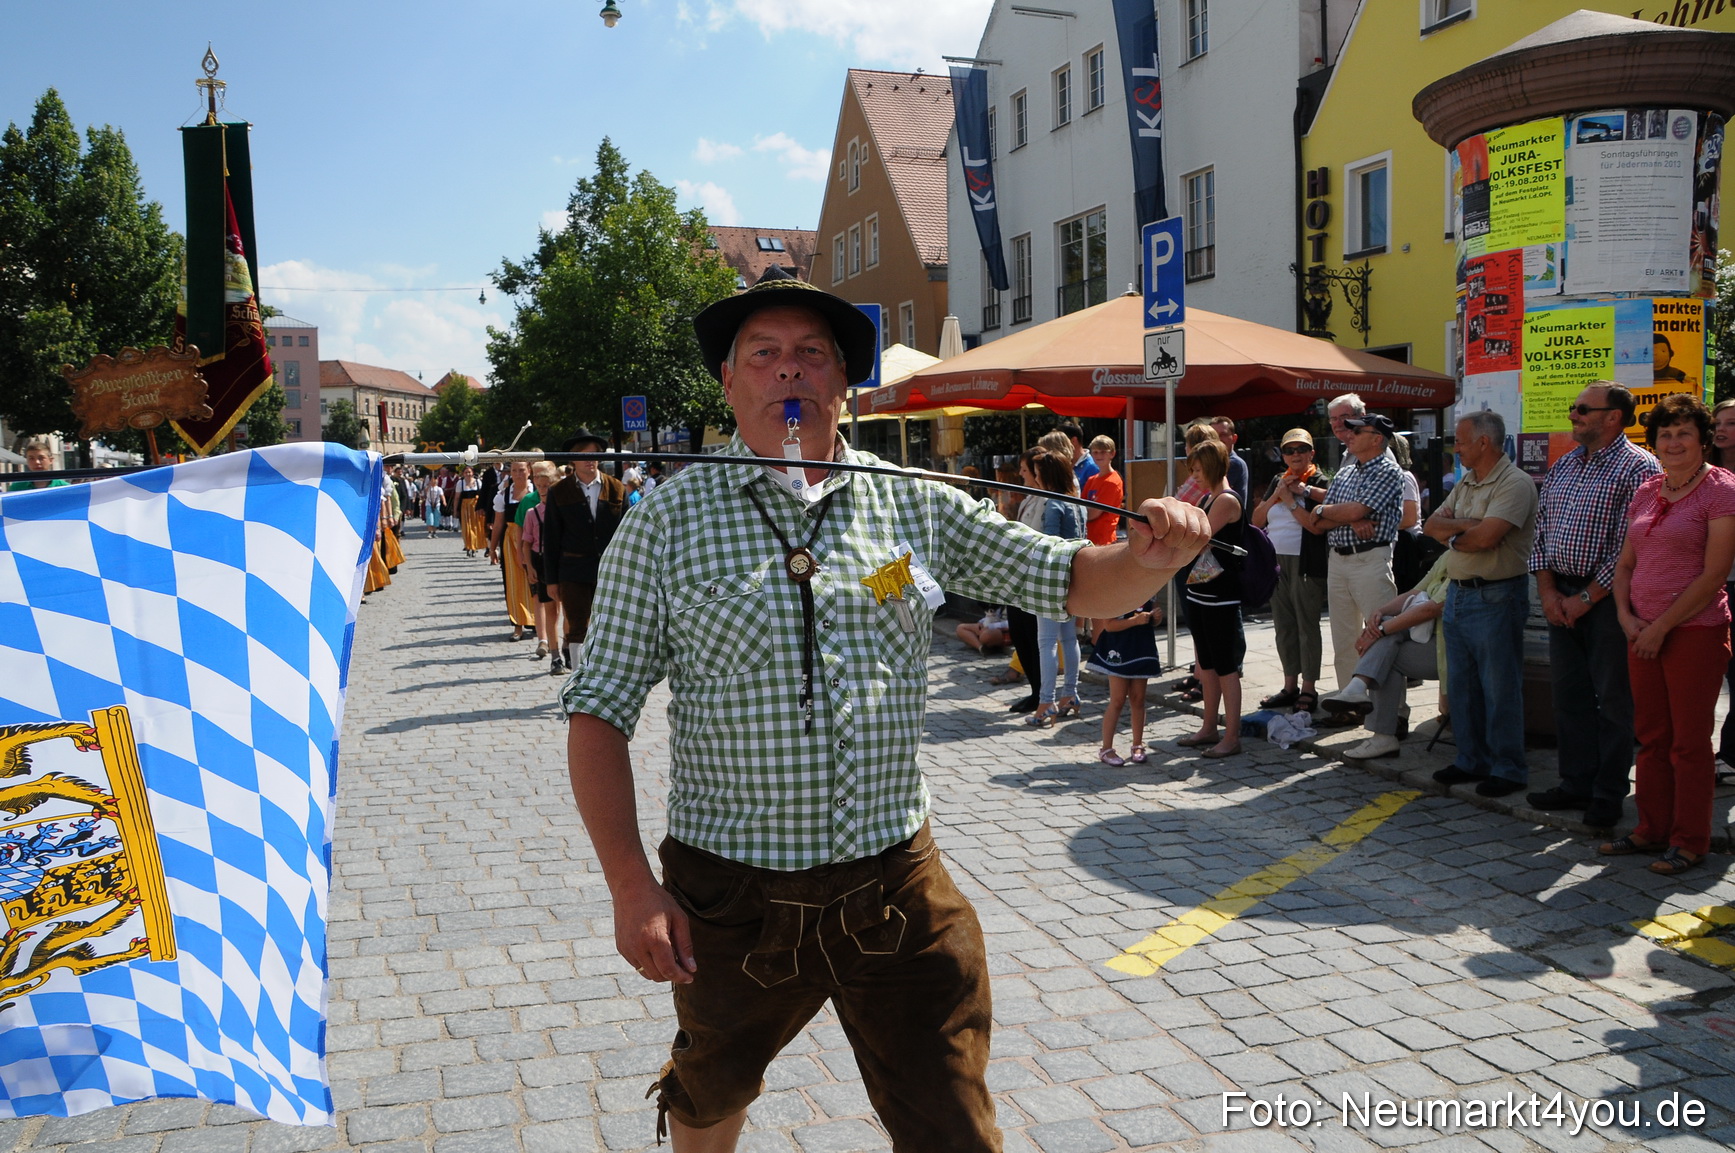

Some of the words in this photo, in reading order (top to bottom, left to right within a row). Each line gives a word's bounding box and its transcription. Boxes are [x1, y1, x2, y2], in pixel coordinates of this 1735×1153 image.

[1489, 134, 1556, 154] Neumarkter
[1500, 150, 1541, 165] JURA-
[1601, 150, 1678, 159] Sonntagsführungen
[1600, 161, 1614, 169] für
[1616, 160, 1662, 169] Jedermann
[1664, 160, 1681, 168] 2013
[1519, 185, 1549, 194] Festplatz
[1499, 195, 1527, 205] Neumarkt
[1305, 166, 1330, 296] HOTE
[1527, 233, 1556, 241] NEUMARKT
[1151, 231, 1174, 293] P
[1508, 253, 1520, 296] Kultur
[1536, 312, 1551, 320] zum
[1530, 321, 1606, 334] Neumarkter
[1157, 336, 1170, 345] nur
[1544, 335, 1590, 347] JURA-
[1524, 347, 1612, 362] VOLKSFEST
[1529, 360, 1606, 372] 09.-19.08.2013
[1565, 372, 1598, 380] Festplatz
[1296, 379, 1320, 390] Hotel
[1323, 379, 1374, 392] Restaurant
[1376, 379, 1436, 398] Lehmeier
[626, 421, 645, 429] TAXI
